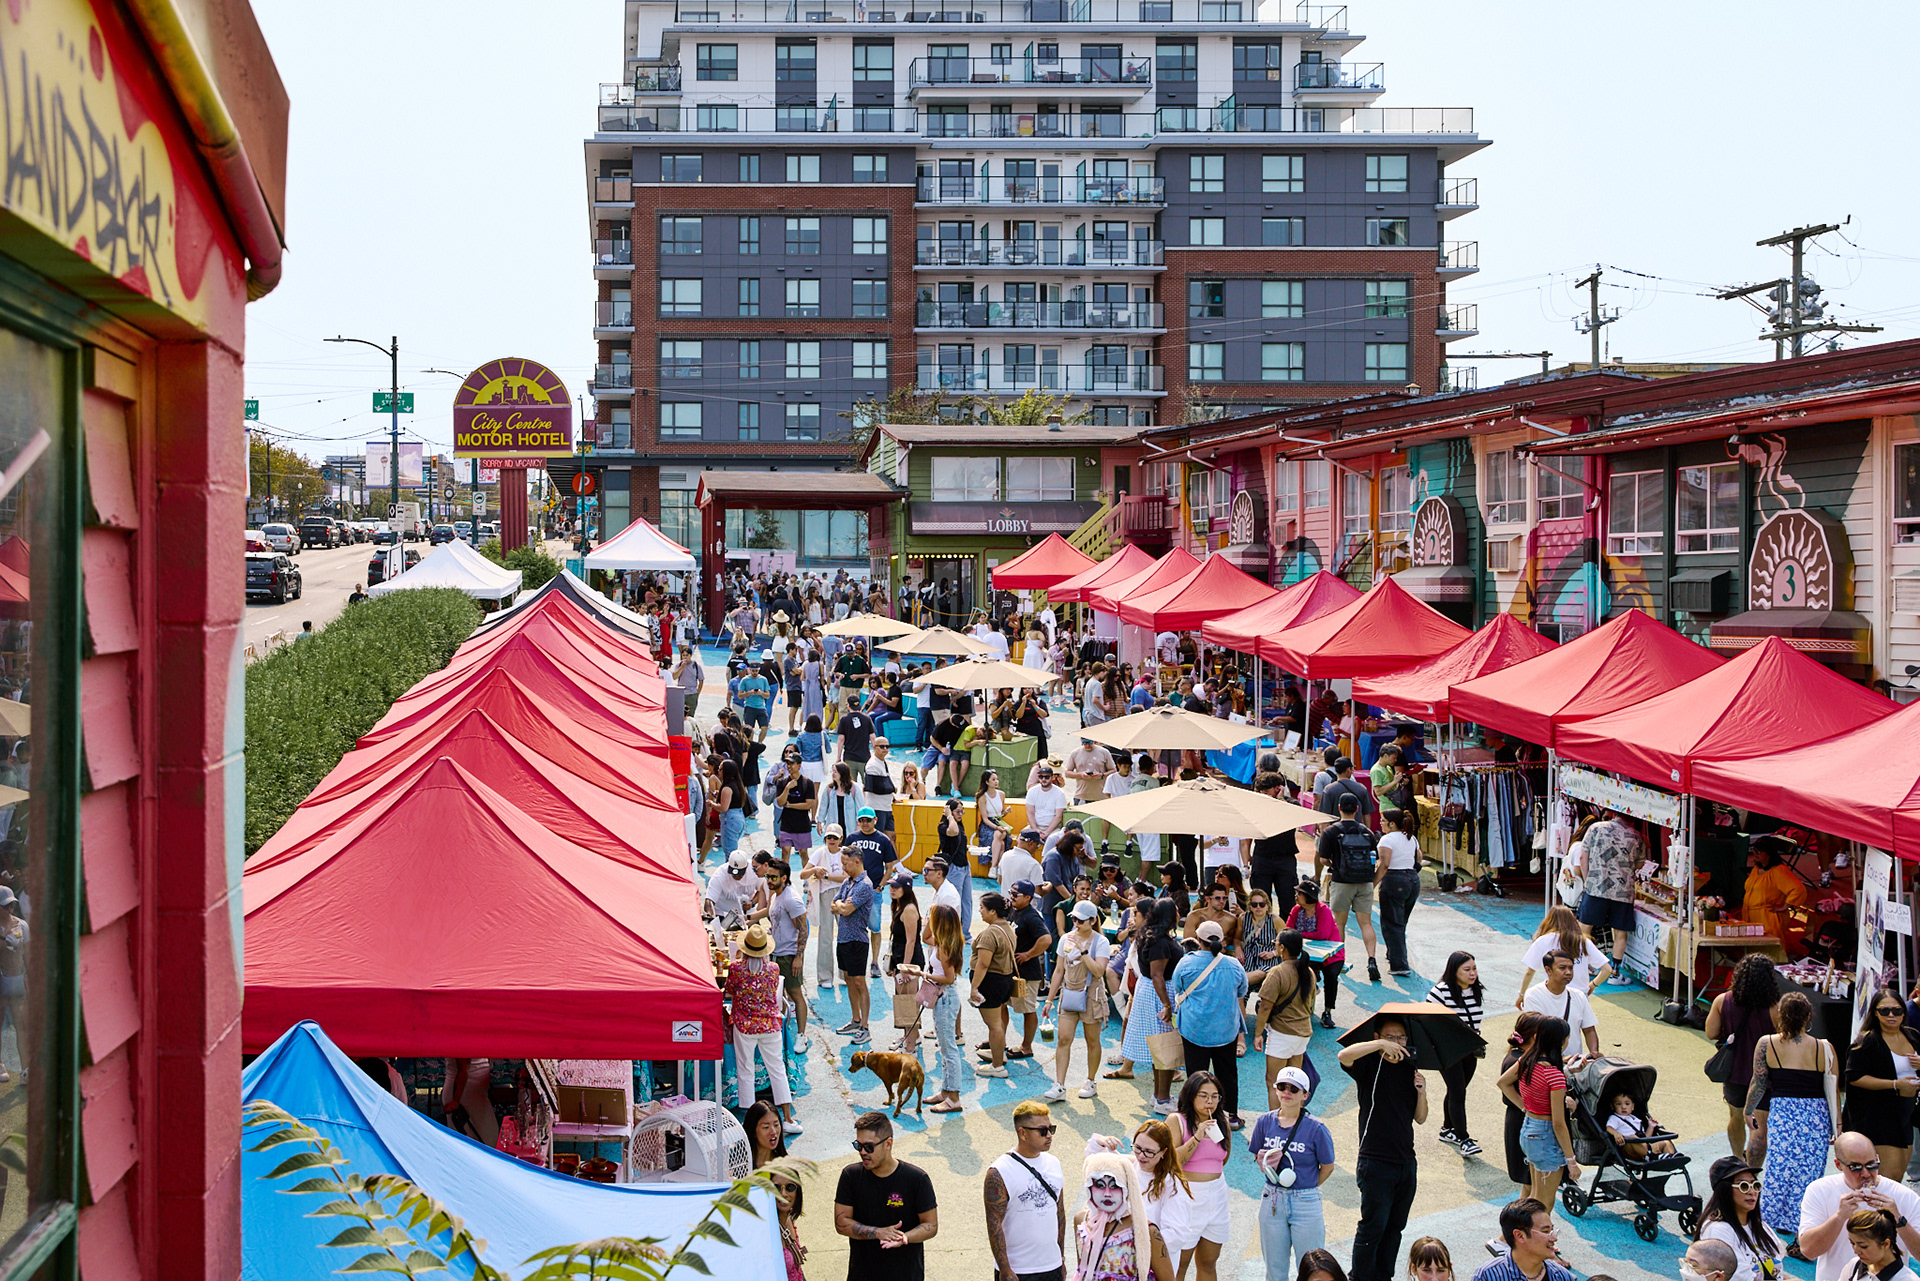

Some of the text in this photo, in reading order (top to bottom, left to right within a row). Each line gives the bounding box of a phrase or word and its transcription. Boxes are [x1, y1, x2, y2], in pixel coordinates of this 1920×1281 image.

[471, 412, 552, 435] City Centre
[457, 433, 570, 446] MOTOR HOTEL
[482, 459, 543, 468] SORRY NO VACANCY
[987, 519, 1029, 533] LOBBY
[1429, 534, 1436, 561] 2
[1782, 564, 1796, 603] 3
[851, 839, 882, 854] SEOUL
[1264, 1136, 1305, 1153] adidas
